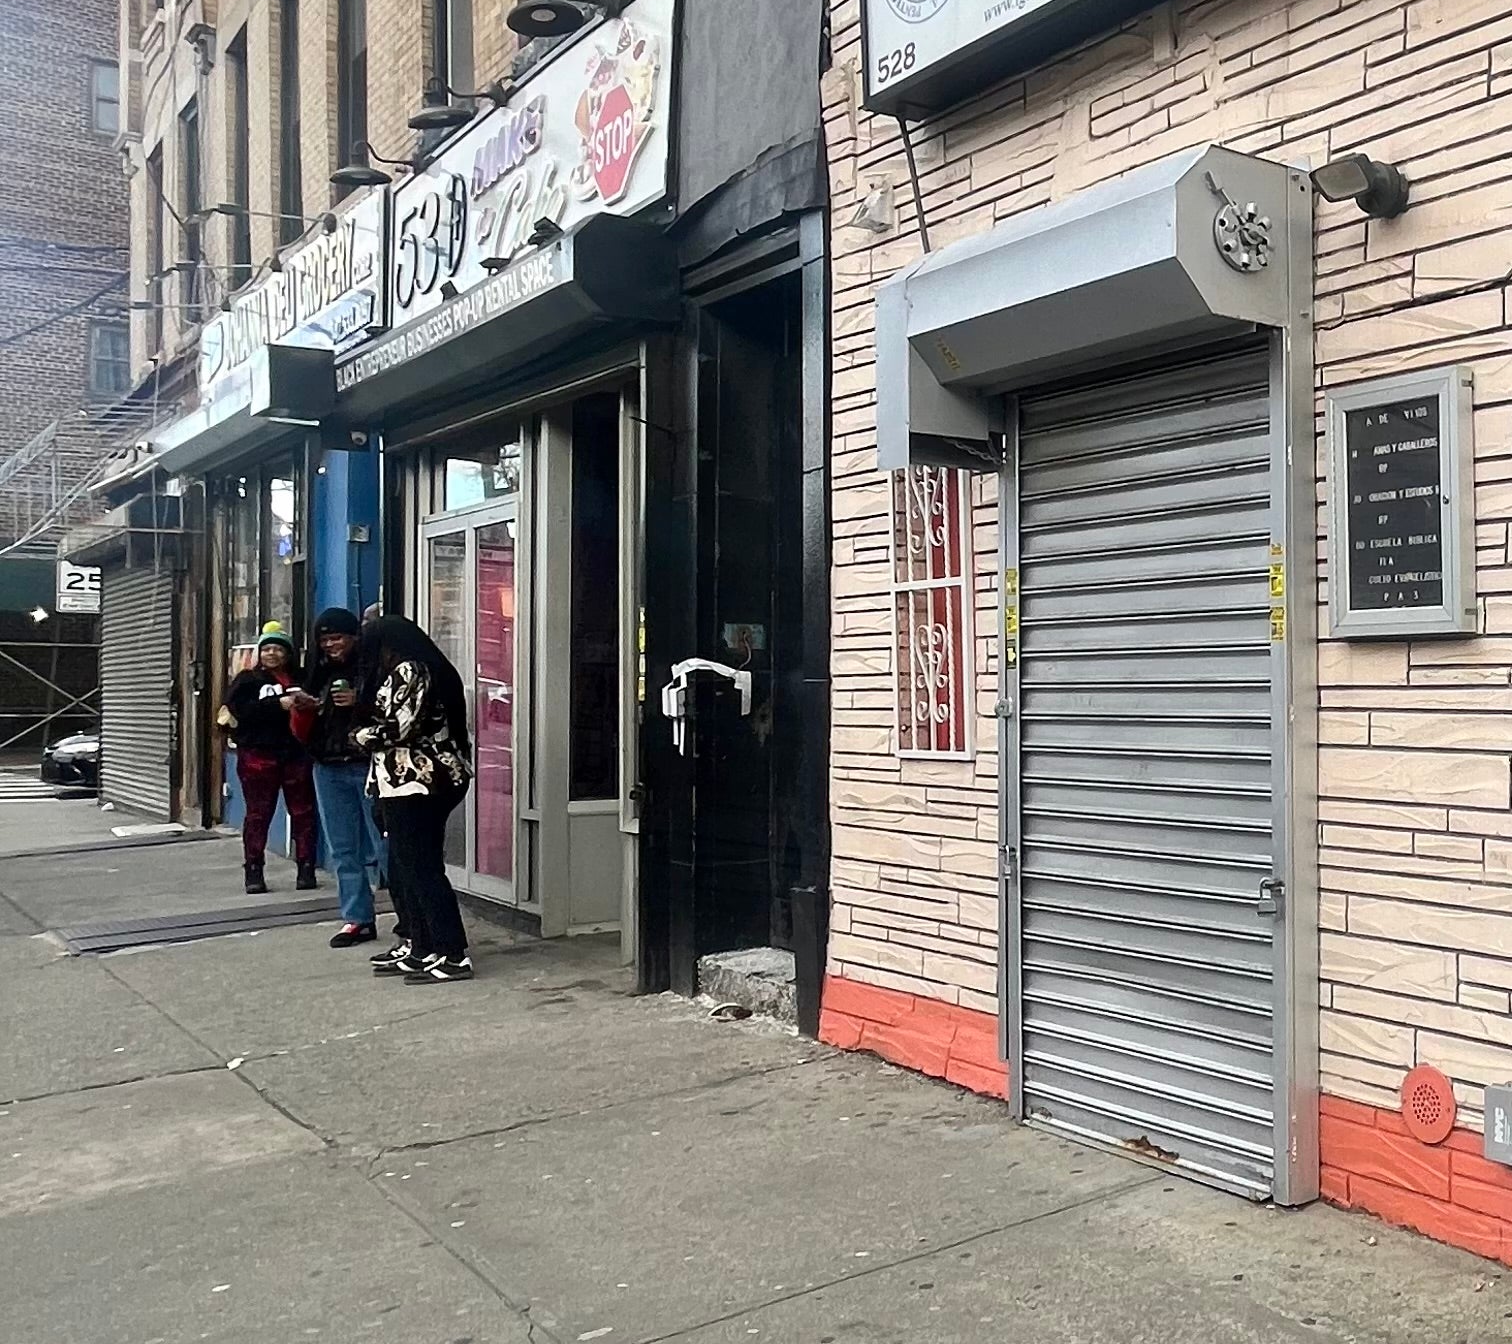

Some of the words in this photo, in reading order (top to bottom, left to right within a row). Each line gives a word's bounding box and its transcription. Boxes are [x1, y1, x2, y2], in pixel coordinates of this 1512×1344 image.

[877, 42, 916, 84] 528
[594, 109, 632, 172] STOP
[521, 252, 555, 296] SPACE
